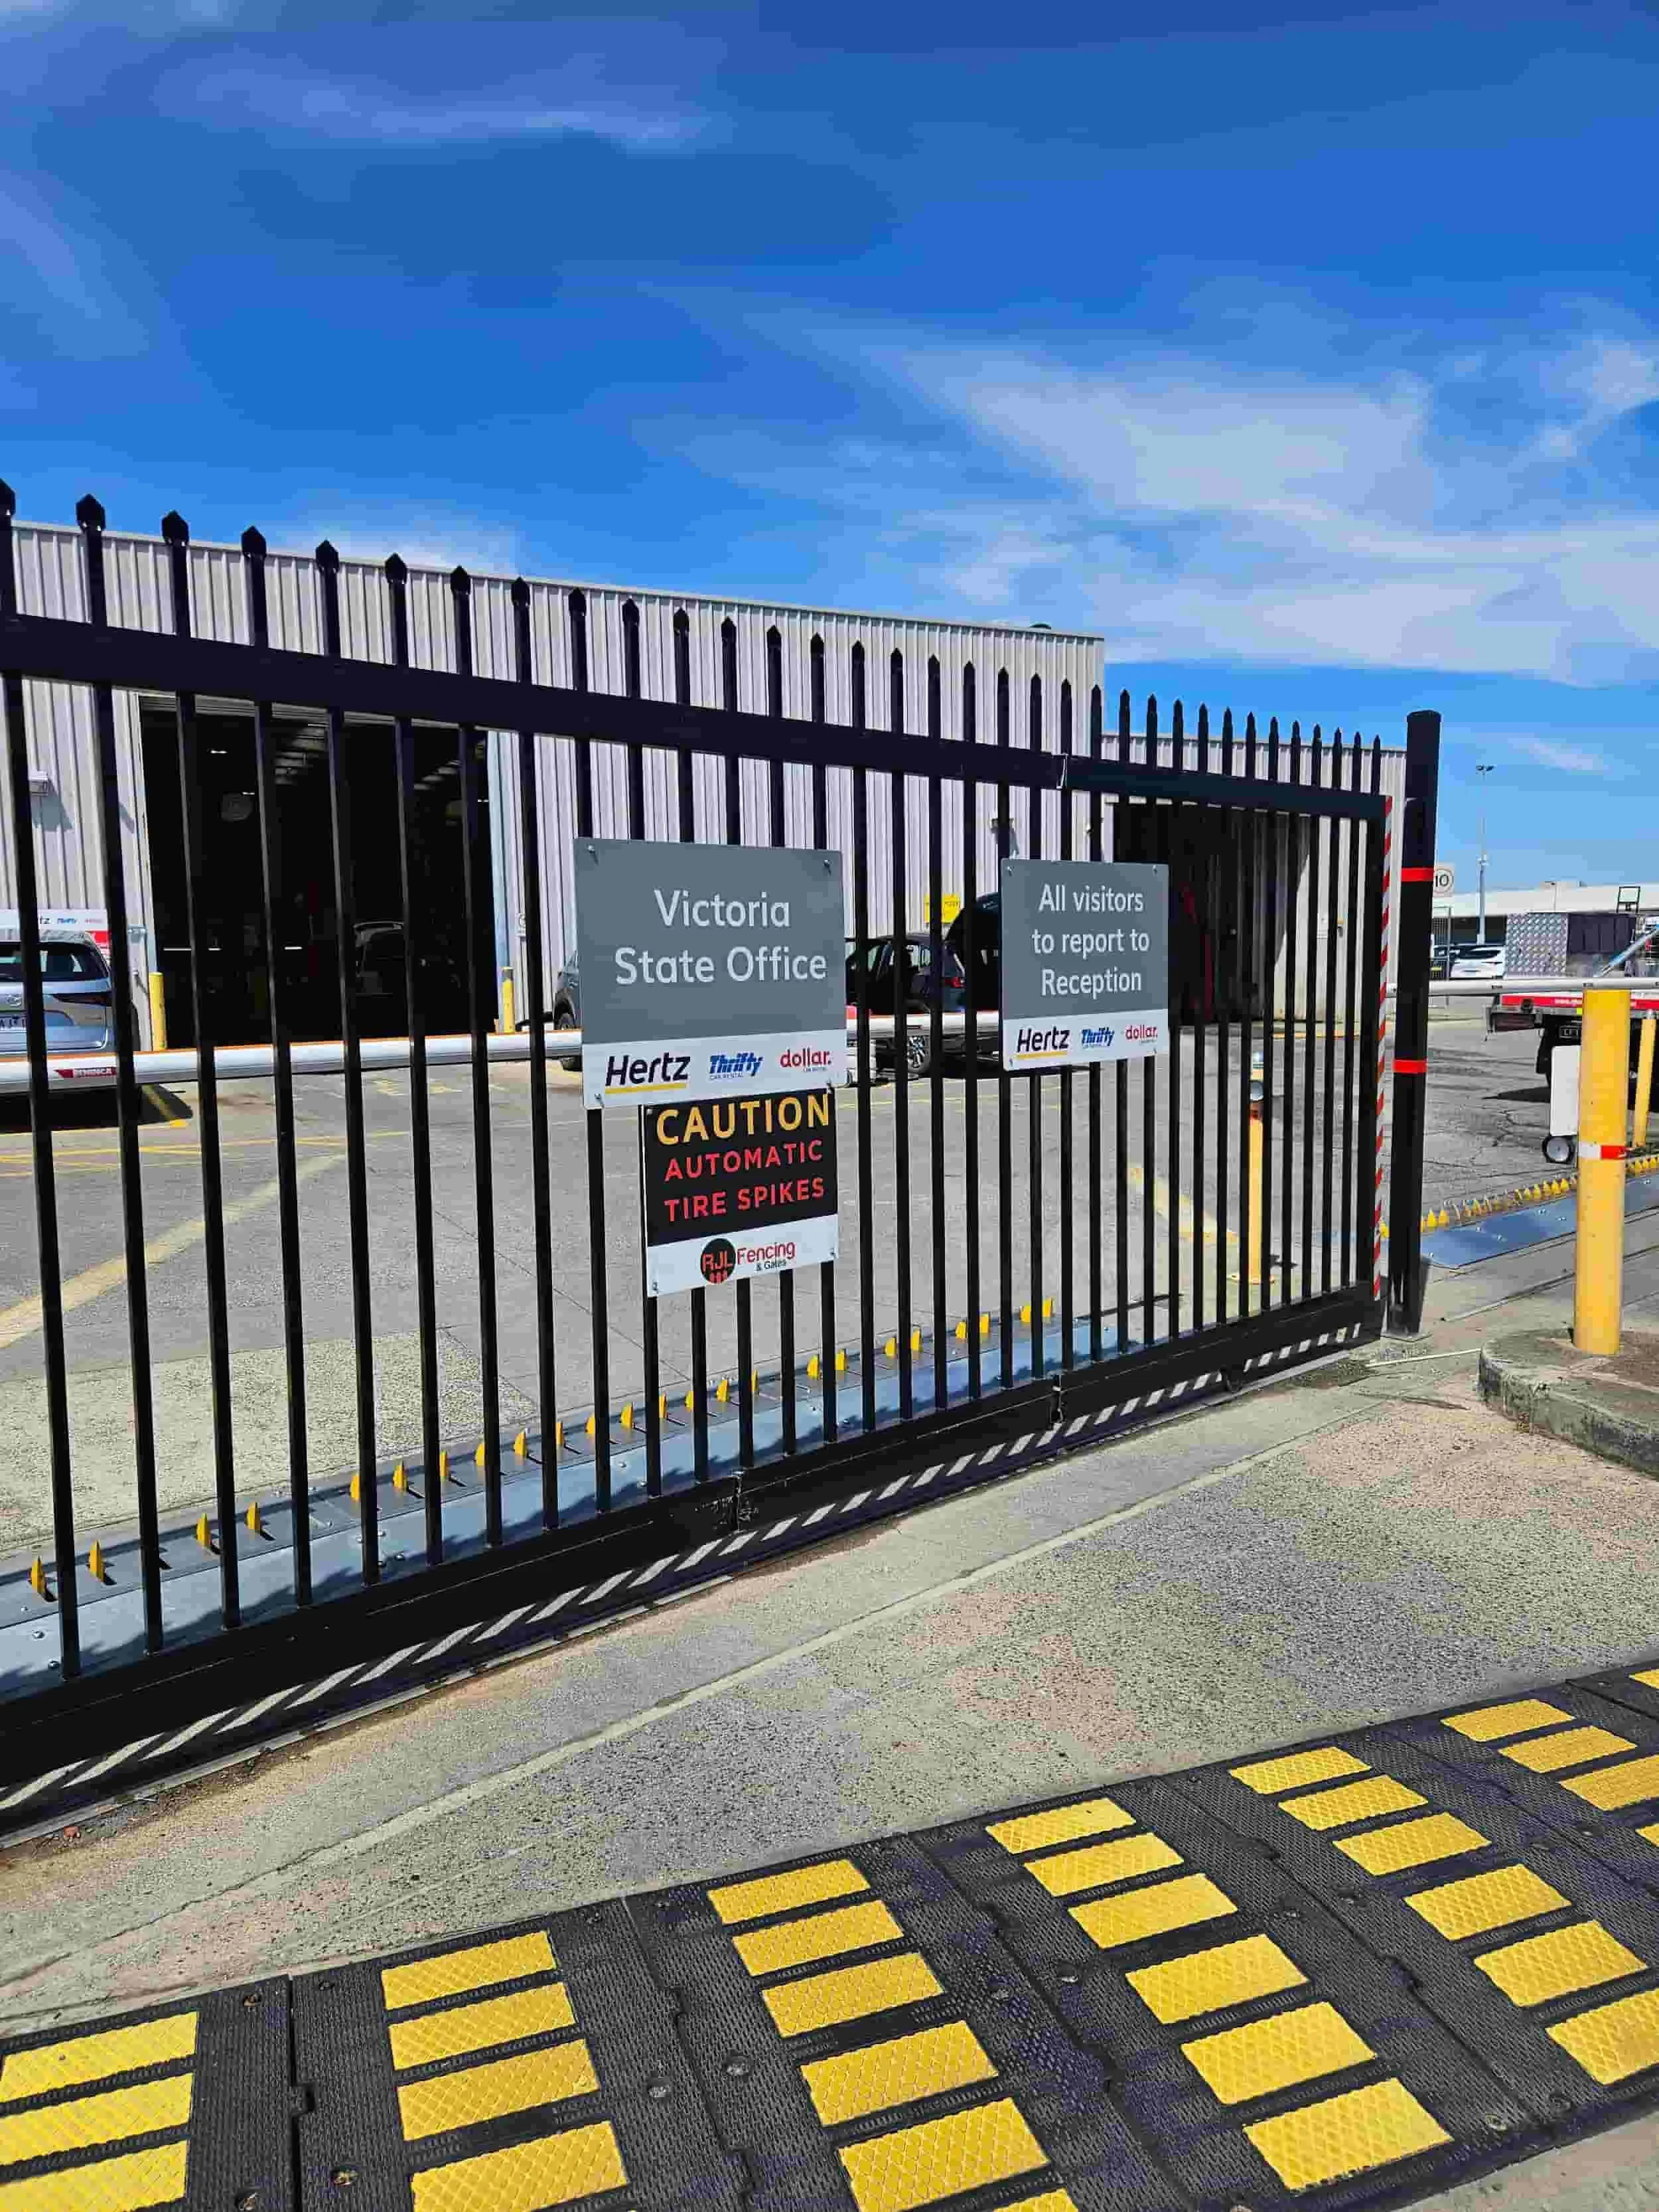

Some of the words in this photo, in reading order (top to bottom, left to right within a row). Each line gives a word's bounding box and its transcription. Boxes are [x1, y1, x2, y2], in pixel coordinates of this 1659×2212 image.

[1435, 874, 1449, 887] 10
[654, 889, 790, 927] Victoria
[1039, 884, 1066, 912] All
[1072, 885, 1144, 913] visitors
[1031, 928, 1054, 954] to
[1062, 929, 1125, 960] report
[1129, 928, 1150, 952] to
[614, 947, 715, 984] State
[727, 946, 827, 982] Office
[1041, 966, 1141, 999] Reception
[1017, 1026, 1070, 1053] Hertz
[1082, 1027, 1115, 1046] Thrifty
[605, 1053, 691, 1086] Hertz
[709, 1053, 763, 1076] Thrifty
[657, 1093, 830, 1145] CAUTION
[664, 1140, 824, 1181] AUTOMATIC
[664, 1191, 727, 1221] TIRE
[738, 1177, 825, 1211] SPIKES
[737, 1242, 796, 1264] Fencing
